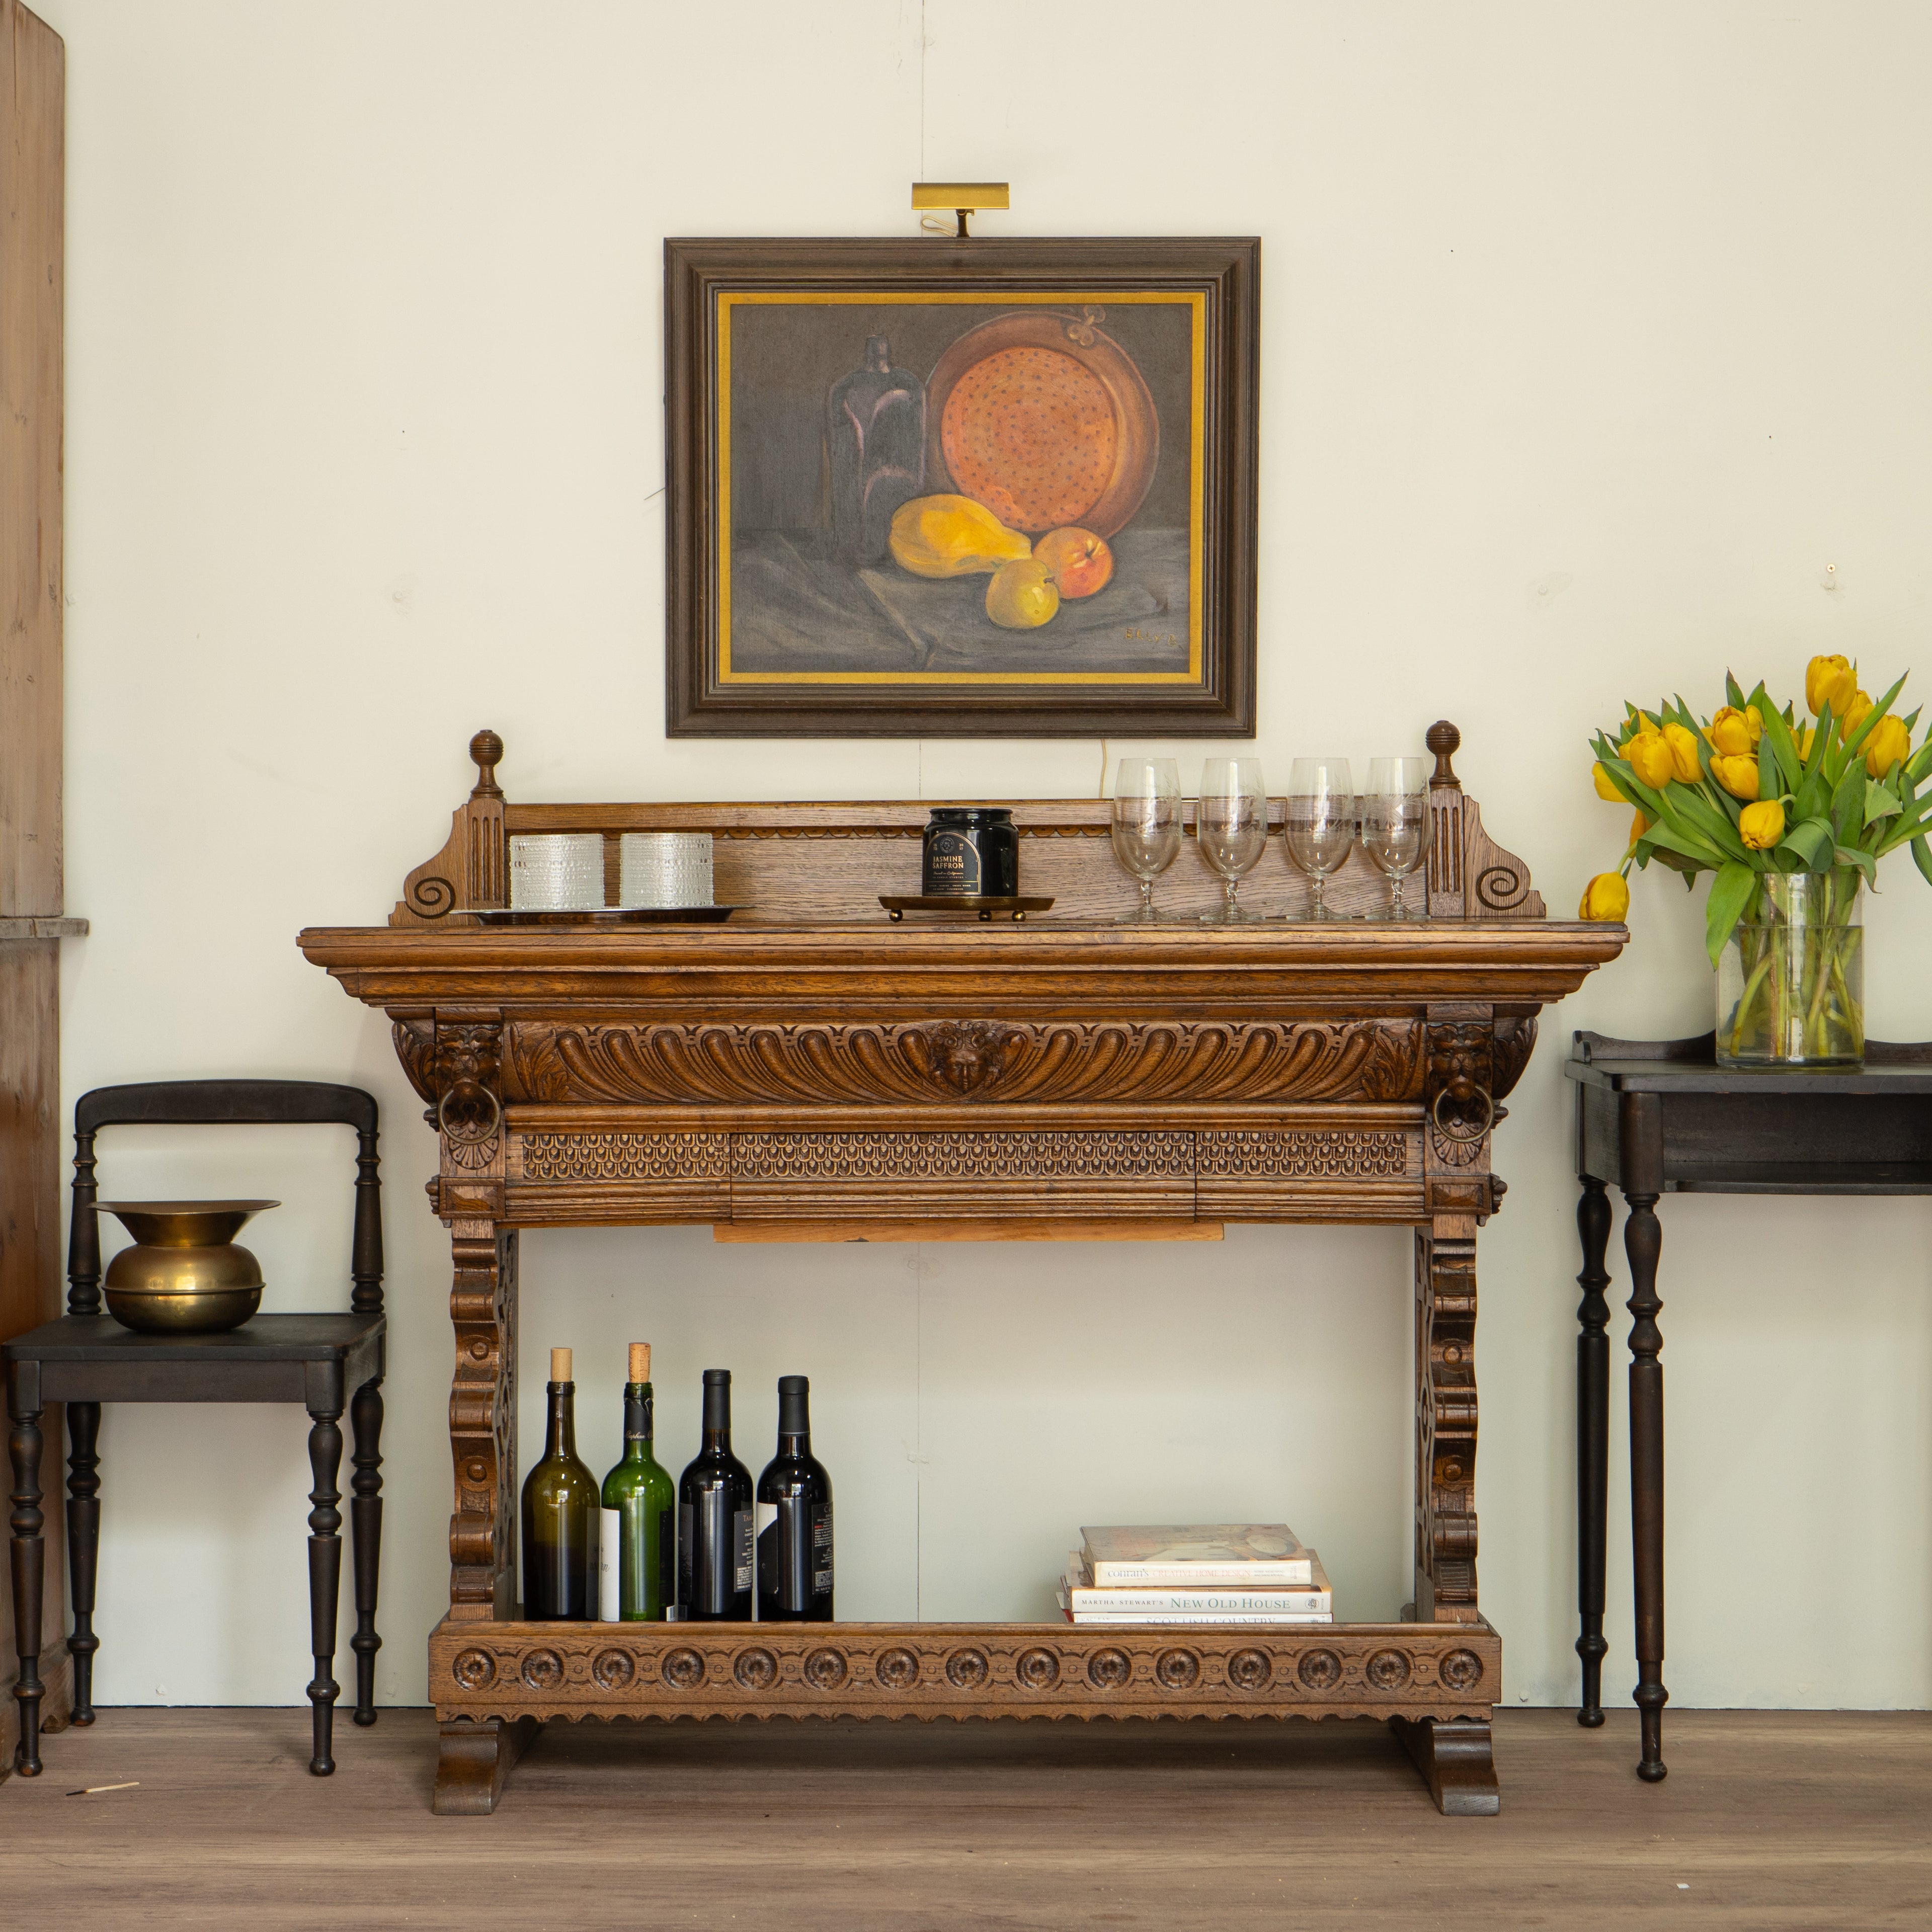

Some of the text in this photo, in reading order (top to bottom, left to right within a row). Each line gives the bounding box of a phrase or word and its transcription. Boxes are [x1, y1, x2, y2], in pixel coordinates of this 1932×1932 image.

[1108, 1568, 1150, 1577] conran's
[1170, 1597, 1203, 1608] NEW
[1208, 1598, 1237, 1608] OLD
[1242, 1598, 1291, 1609] HOUSE
